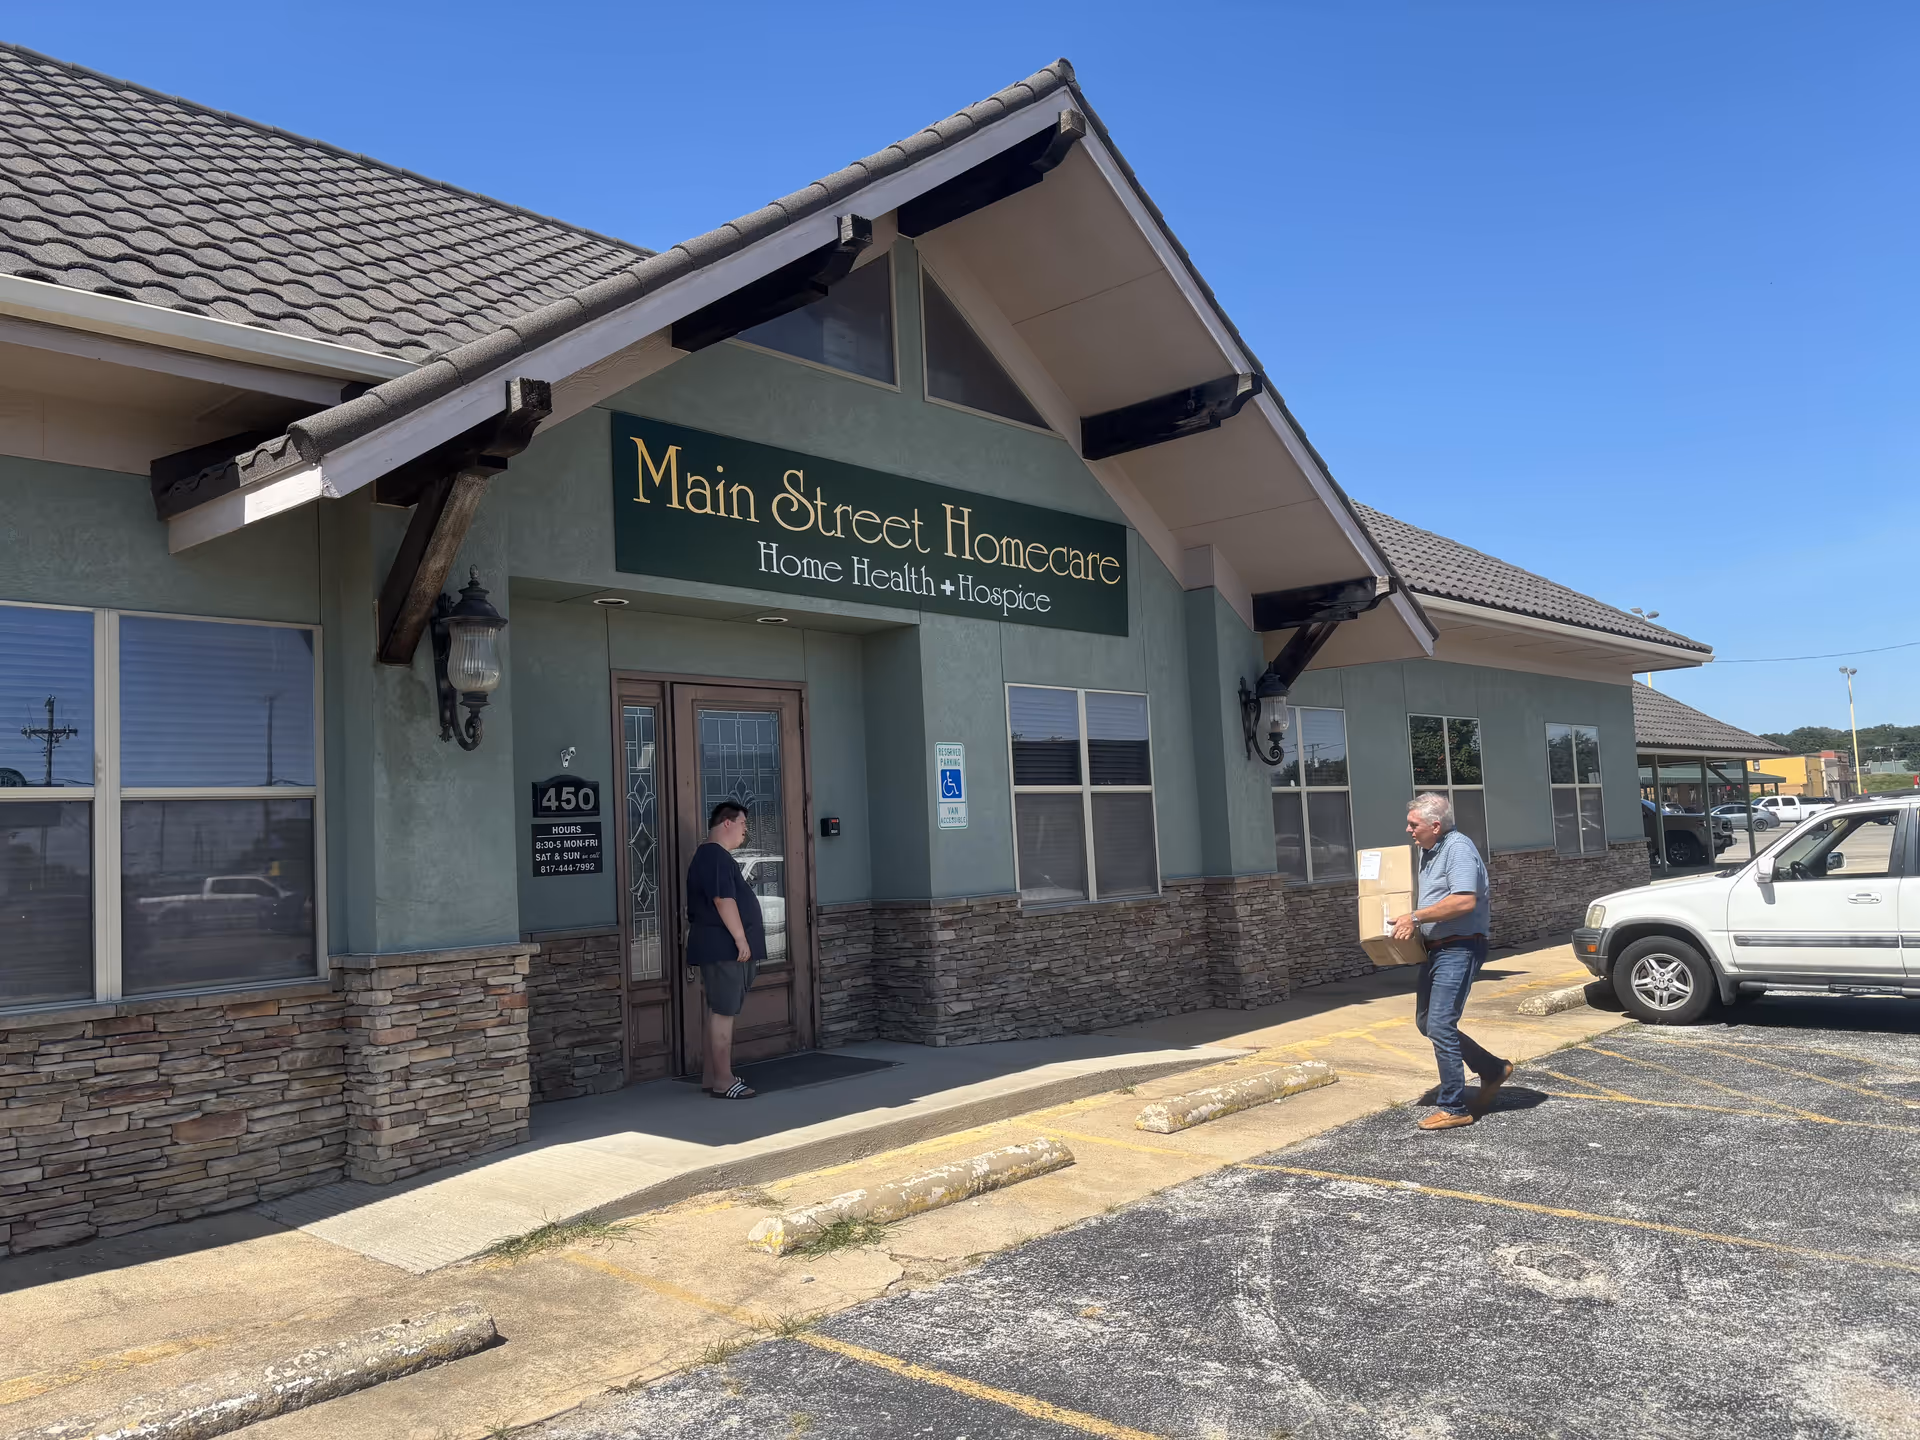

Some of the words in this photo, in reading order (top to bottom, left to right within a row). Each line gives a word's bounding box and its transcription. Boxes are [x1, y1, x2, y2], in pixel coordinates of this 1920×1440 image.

[630, 437, 759, 522] Main
[771, 469, 930, 553] Street
[941, 503, 1121, 585] Homecare
[757, 540, 843, 582] Home
[851, 556, 936, 596] Health
[957, 573, 1051, 617] Hospice
[541, 786, 595, 811] 450
[947, 806, 959, 815] VAN
[552, 825, 582, 834] HOURS
[535, 840, 562, 849] 8:30-5
[563, 839, 598, 848] MON-FRI
[535, 853, 551, 861] SAT
[563, 852, 580, 860] SUN
[540, 863, 595, 873] 817-444-7992
